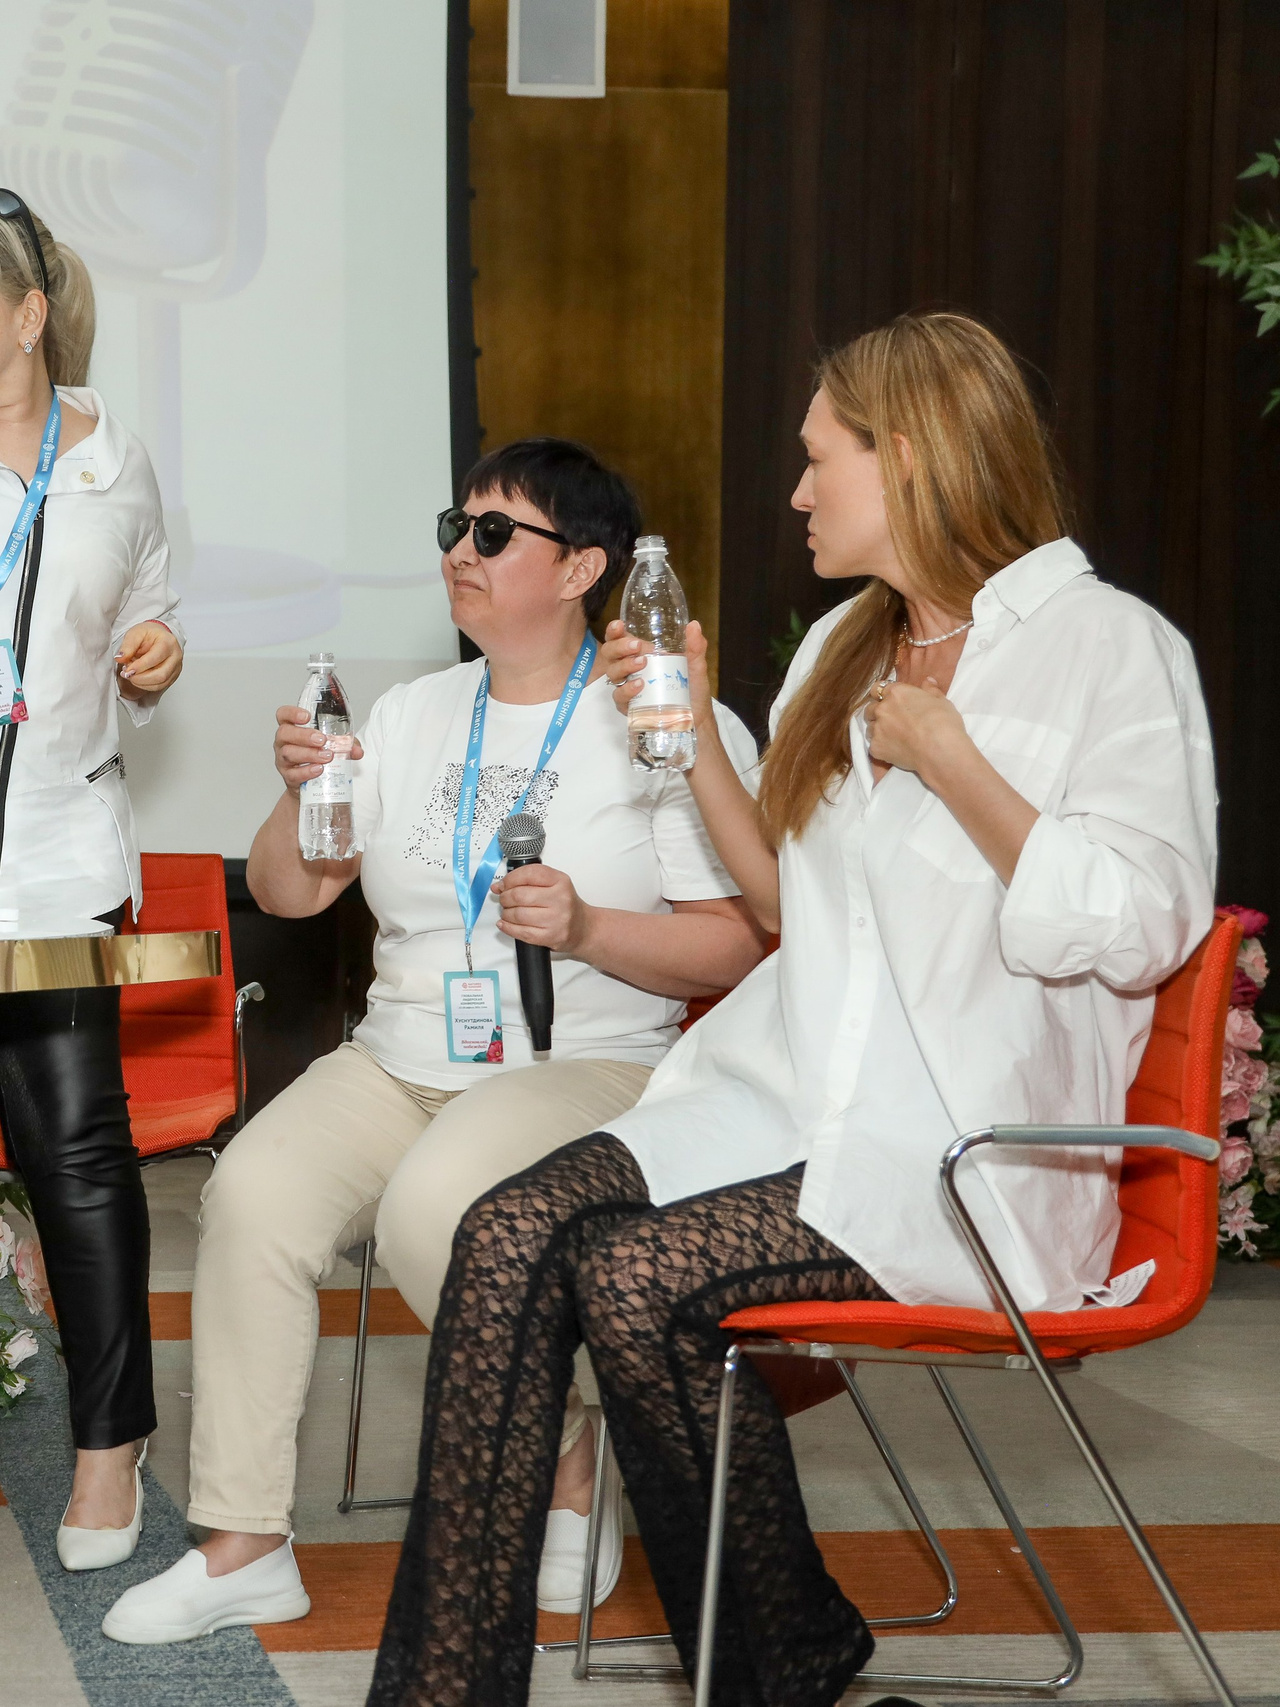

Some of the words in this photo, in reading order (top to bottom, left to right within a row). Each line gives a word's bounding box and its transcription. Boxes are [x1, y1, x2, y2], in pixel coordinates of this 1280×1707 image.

[17, 501, 36, 534] SUNSHINE
[555, 688, 576, 728] SUNSHINE
[461, 785, 473, 825] SUNSHINE
